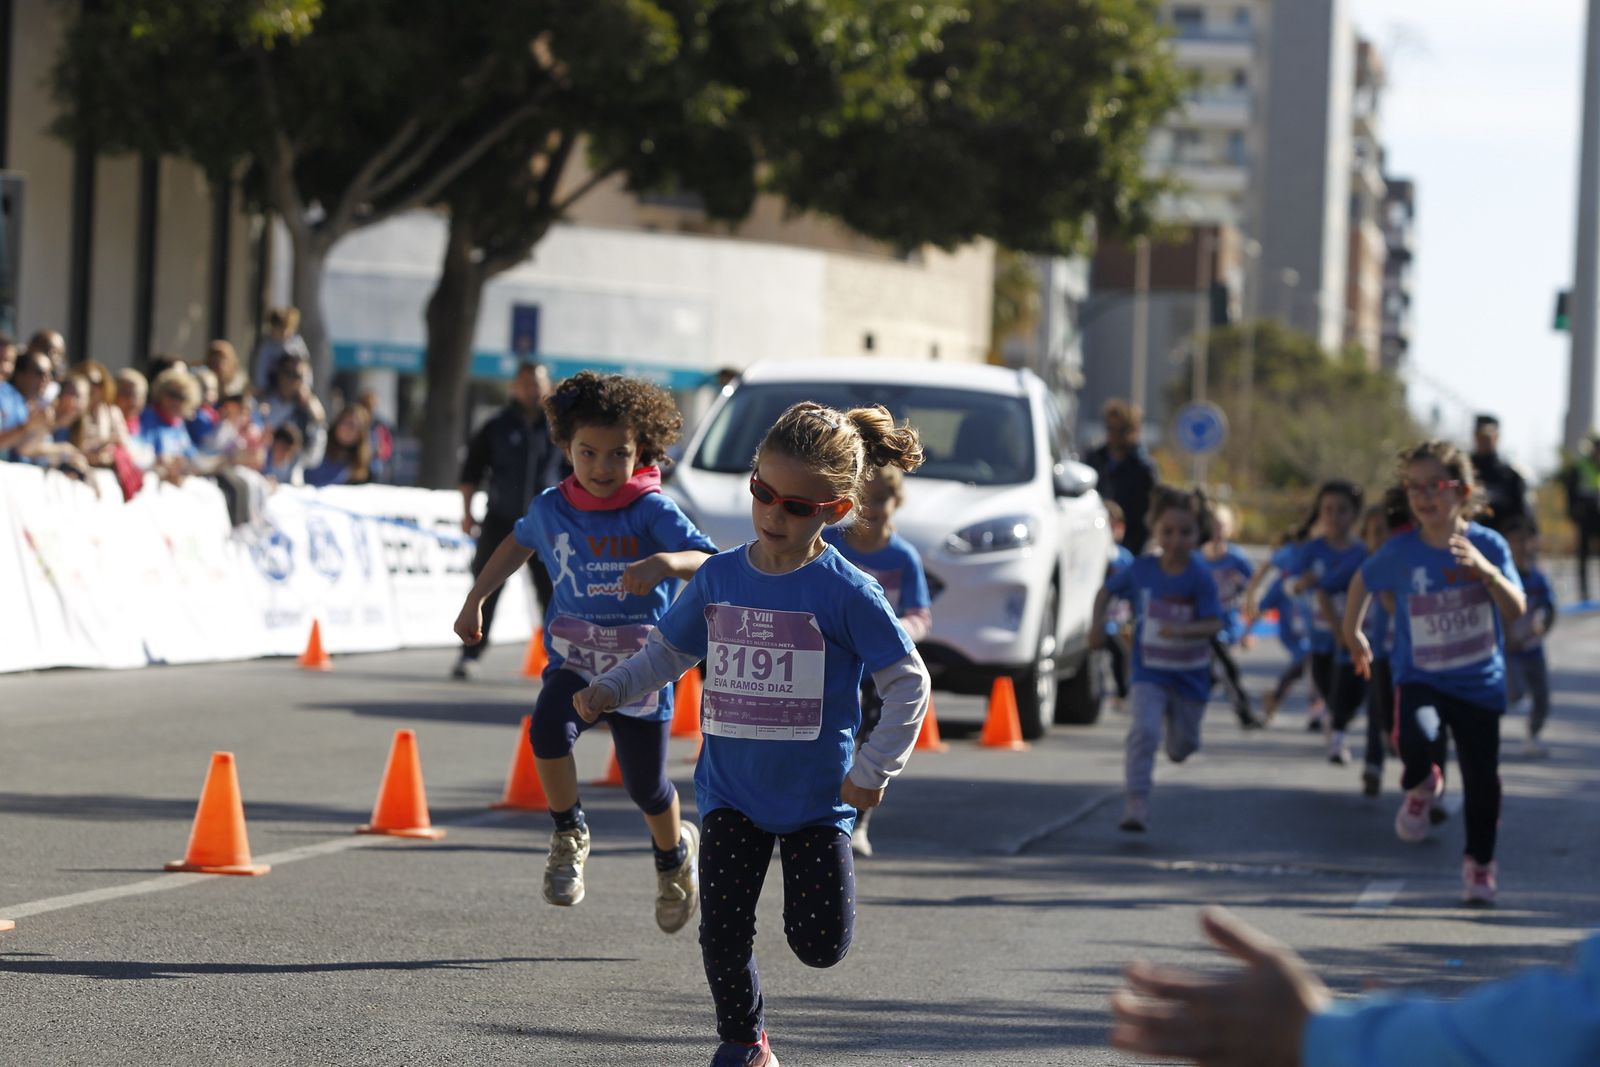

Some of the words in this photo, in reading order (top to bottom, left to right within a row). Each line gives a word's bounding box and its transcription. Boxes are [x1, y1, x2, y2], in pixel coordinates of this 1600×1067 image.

[586, 535, 639, 557] VIII
[753, 611, 774, 623] VIII
[599, 629, 617, 637] VIII
[714, 644, 794, 682] 3191
[714, 677, 728, 688] EVA
[729, 679, 765, 692] RAMOS
[767, 683, 793, 693] DIAZ
